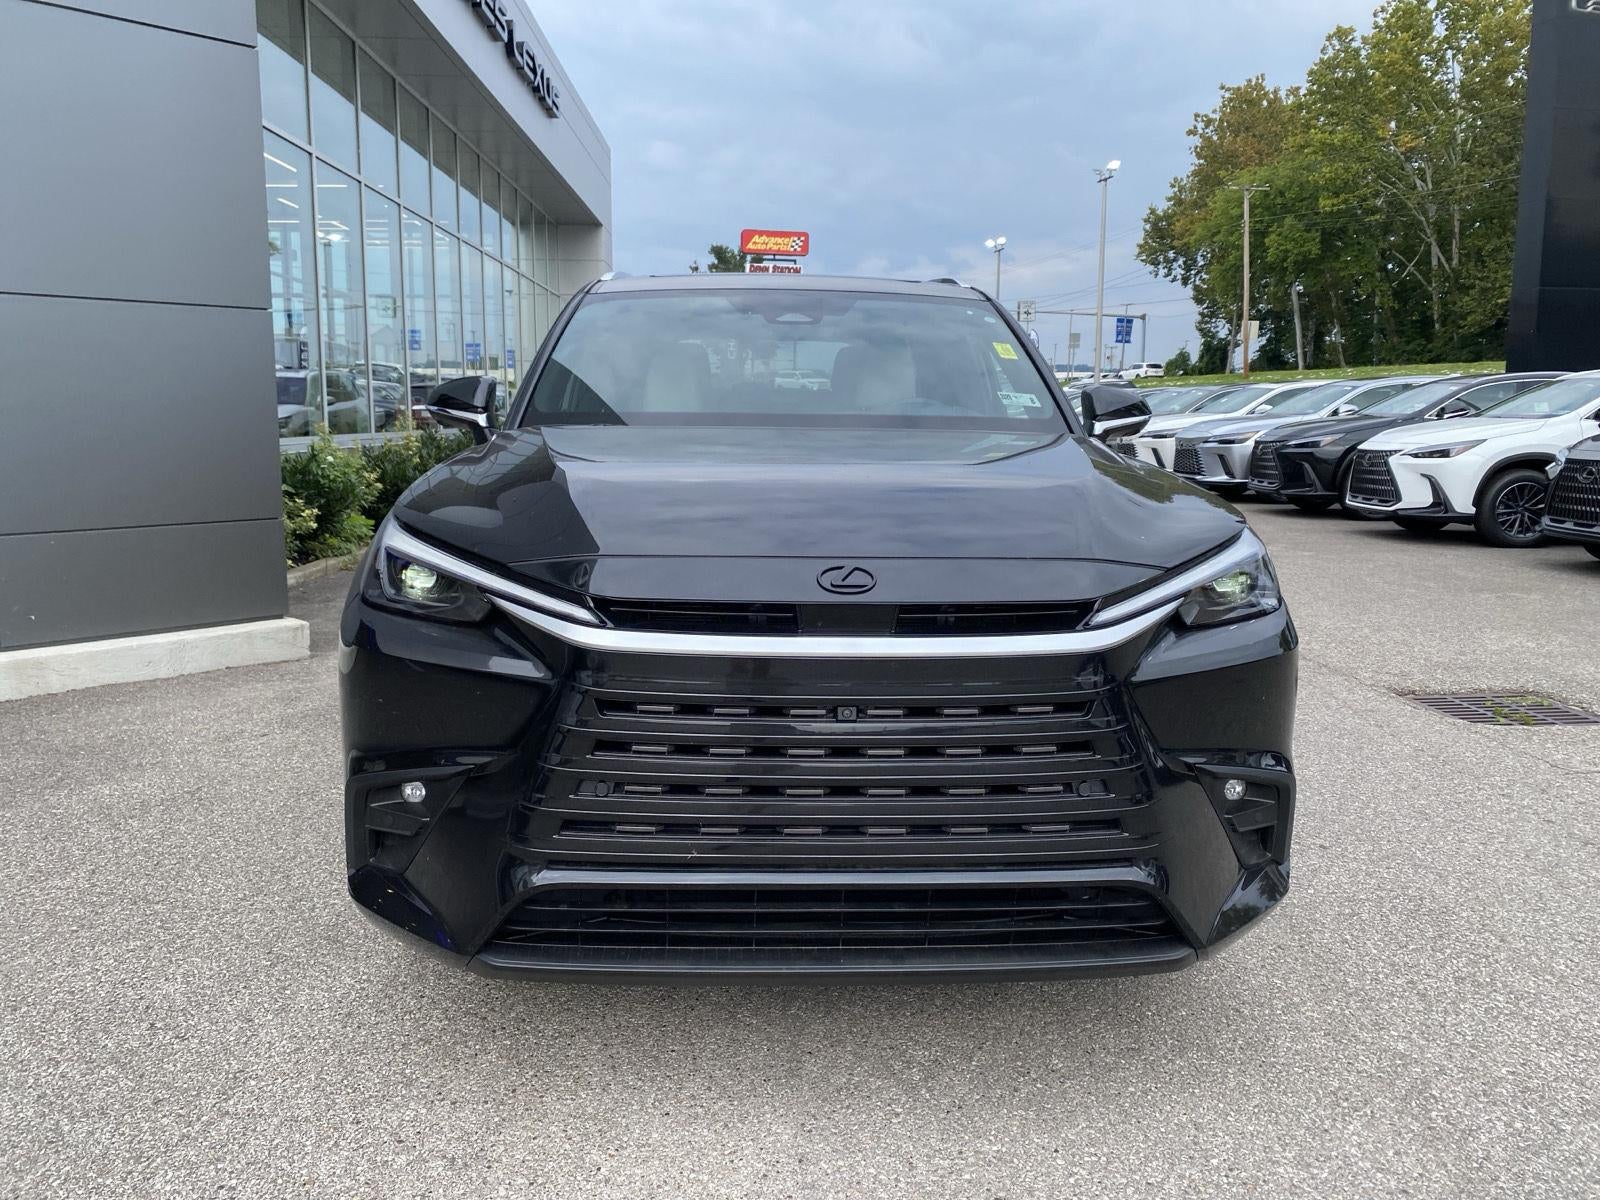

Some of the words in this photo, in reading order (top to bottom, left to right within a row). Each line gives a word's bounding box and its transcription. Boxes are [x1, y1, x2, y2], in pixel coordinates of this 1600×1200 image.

[505, 19, 560, 118] LEXUS
[751, 235, 790, 243] Advance
[746, 242, 767, 250] Auto
[767, 242, 789, 251] Parts
